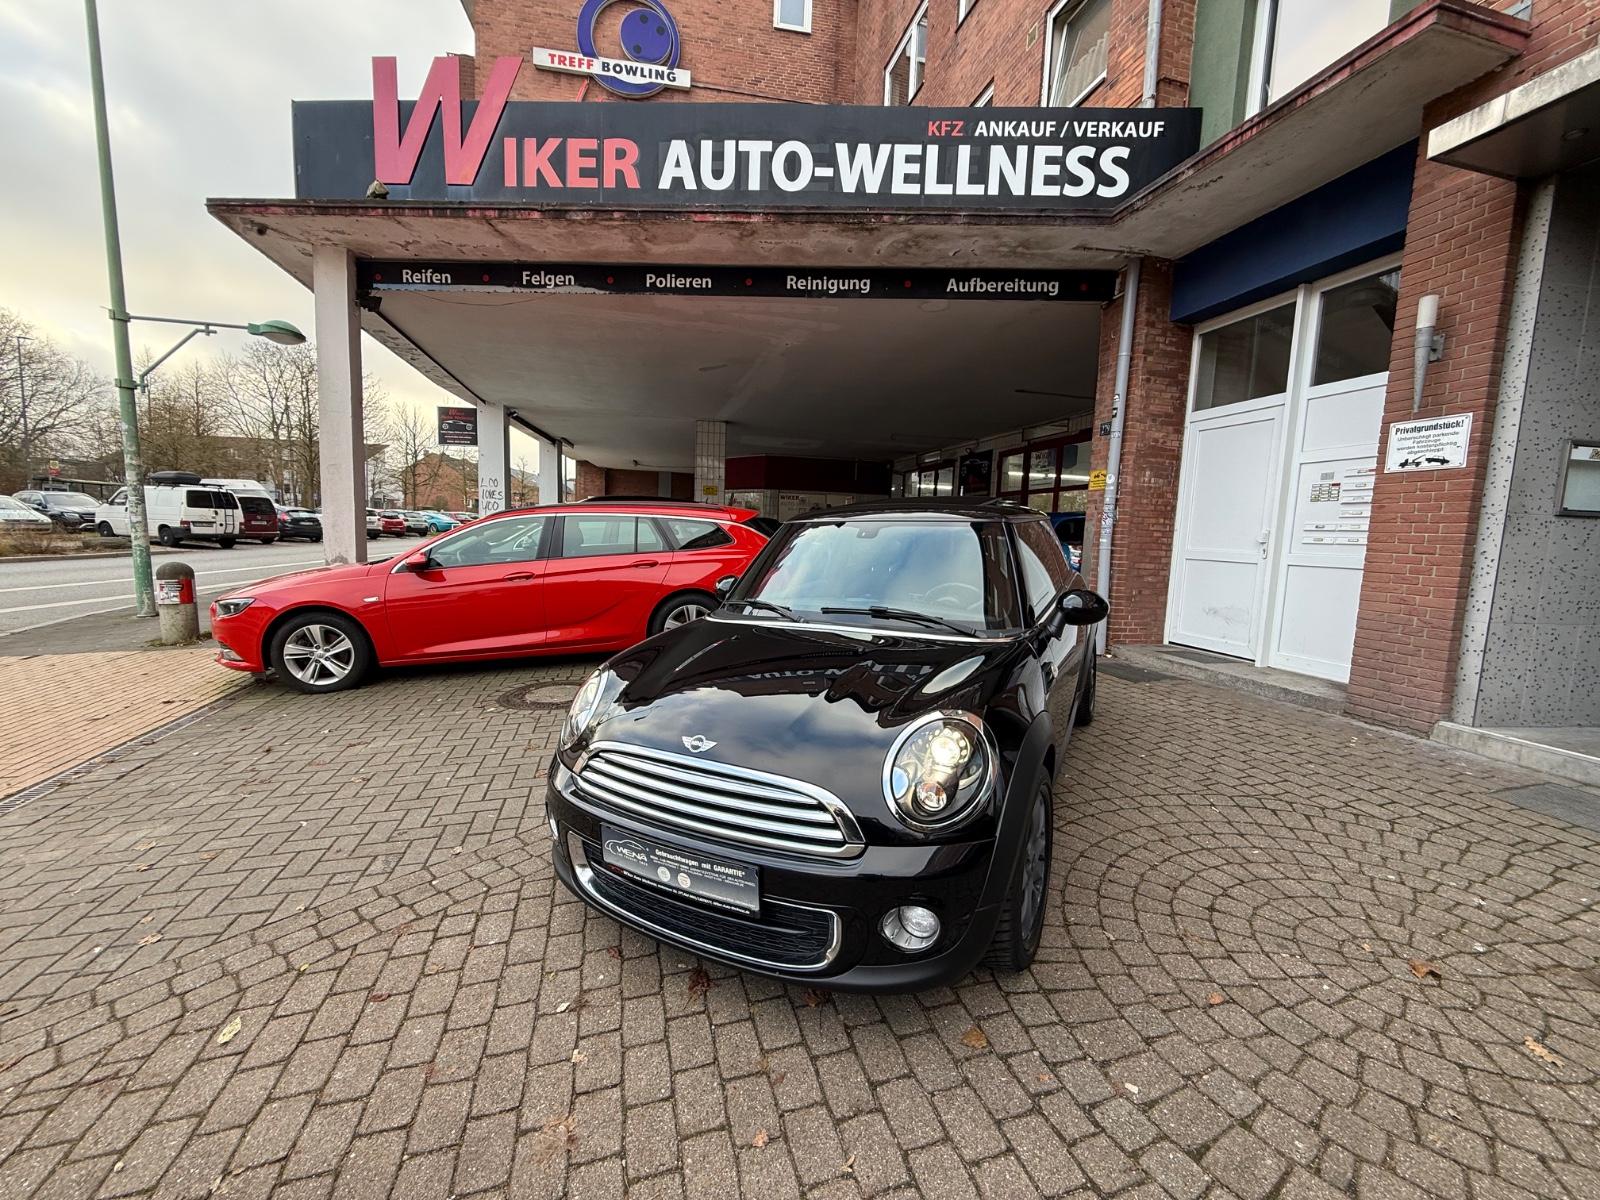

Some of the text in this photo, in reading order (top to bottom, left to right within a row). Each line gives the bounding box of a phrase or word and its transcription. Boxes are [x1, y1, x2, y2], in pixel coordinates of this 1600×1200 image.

[548, 53, 677, 83] TREFF BOWLING
[927, 121, 964, 137] KFZ
[974, 121, 1057, 138] ANKAUF
[1073, 121, 1165, 138] VERKAUF
[658, 139, 1130, 198] AUTO-WELLNESS
[402, 269, 1059, 296] Reifen Felgen Polieren Reinigung Aufbereitung
[1395, 420, 1464, 435] Privatgrundstück!
